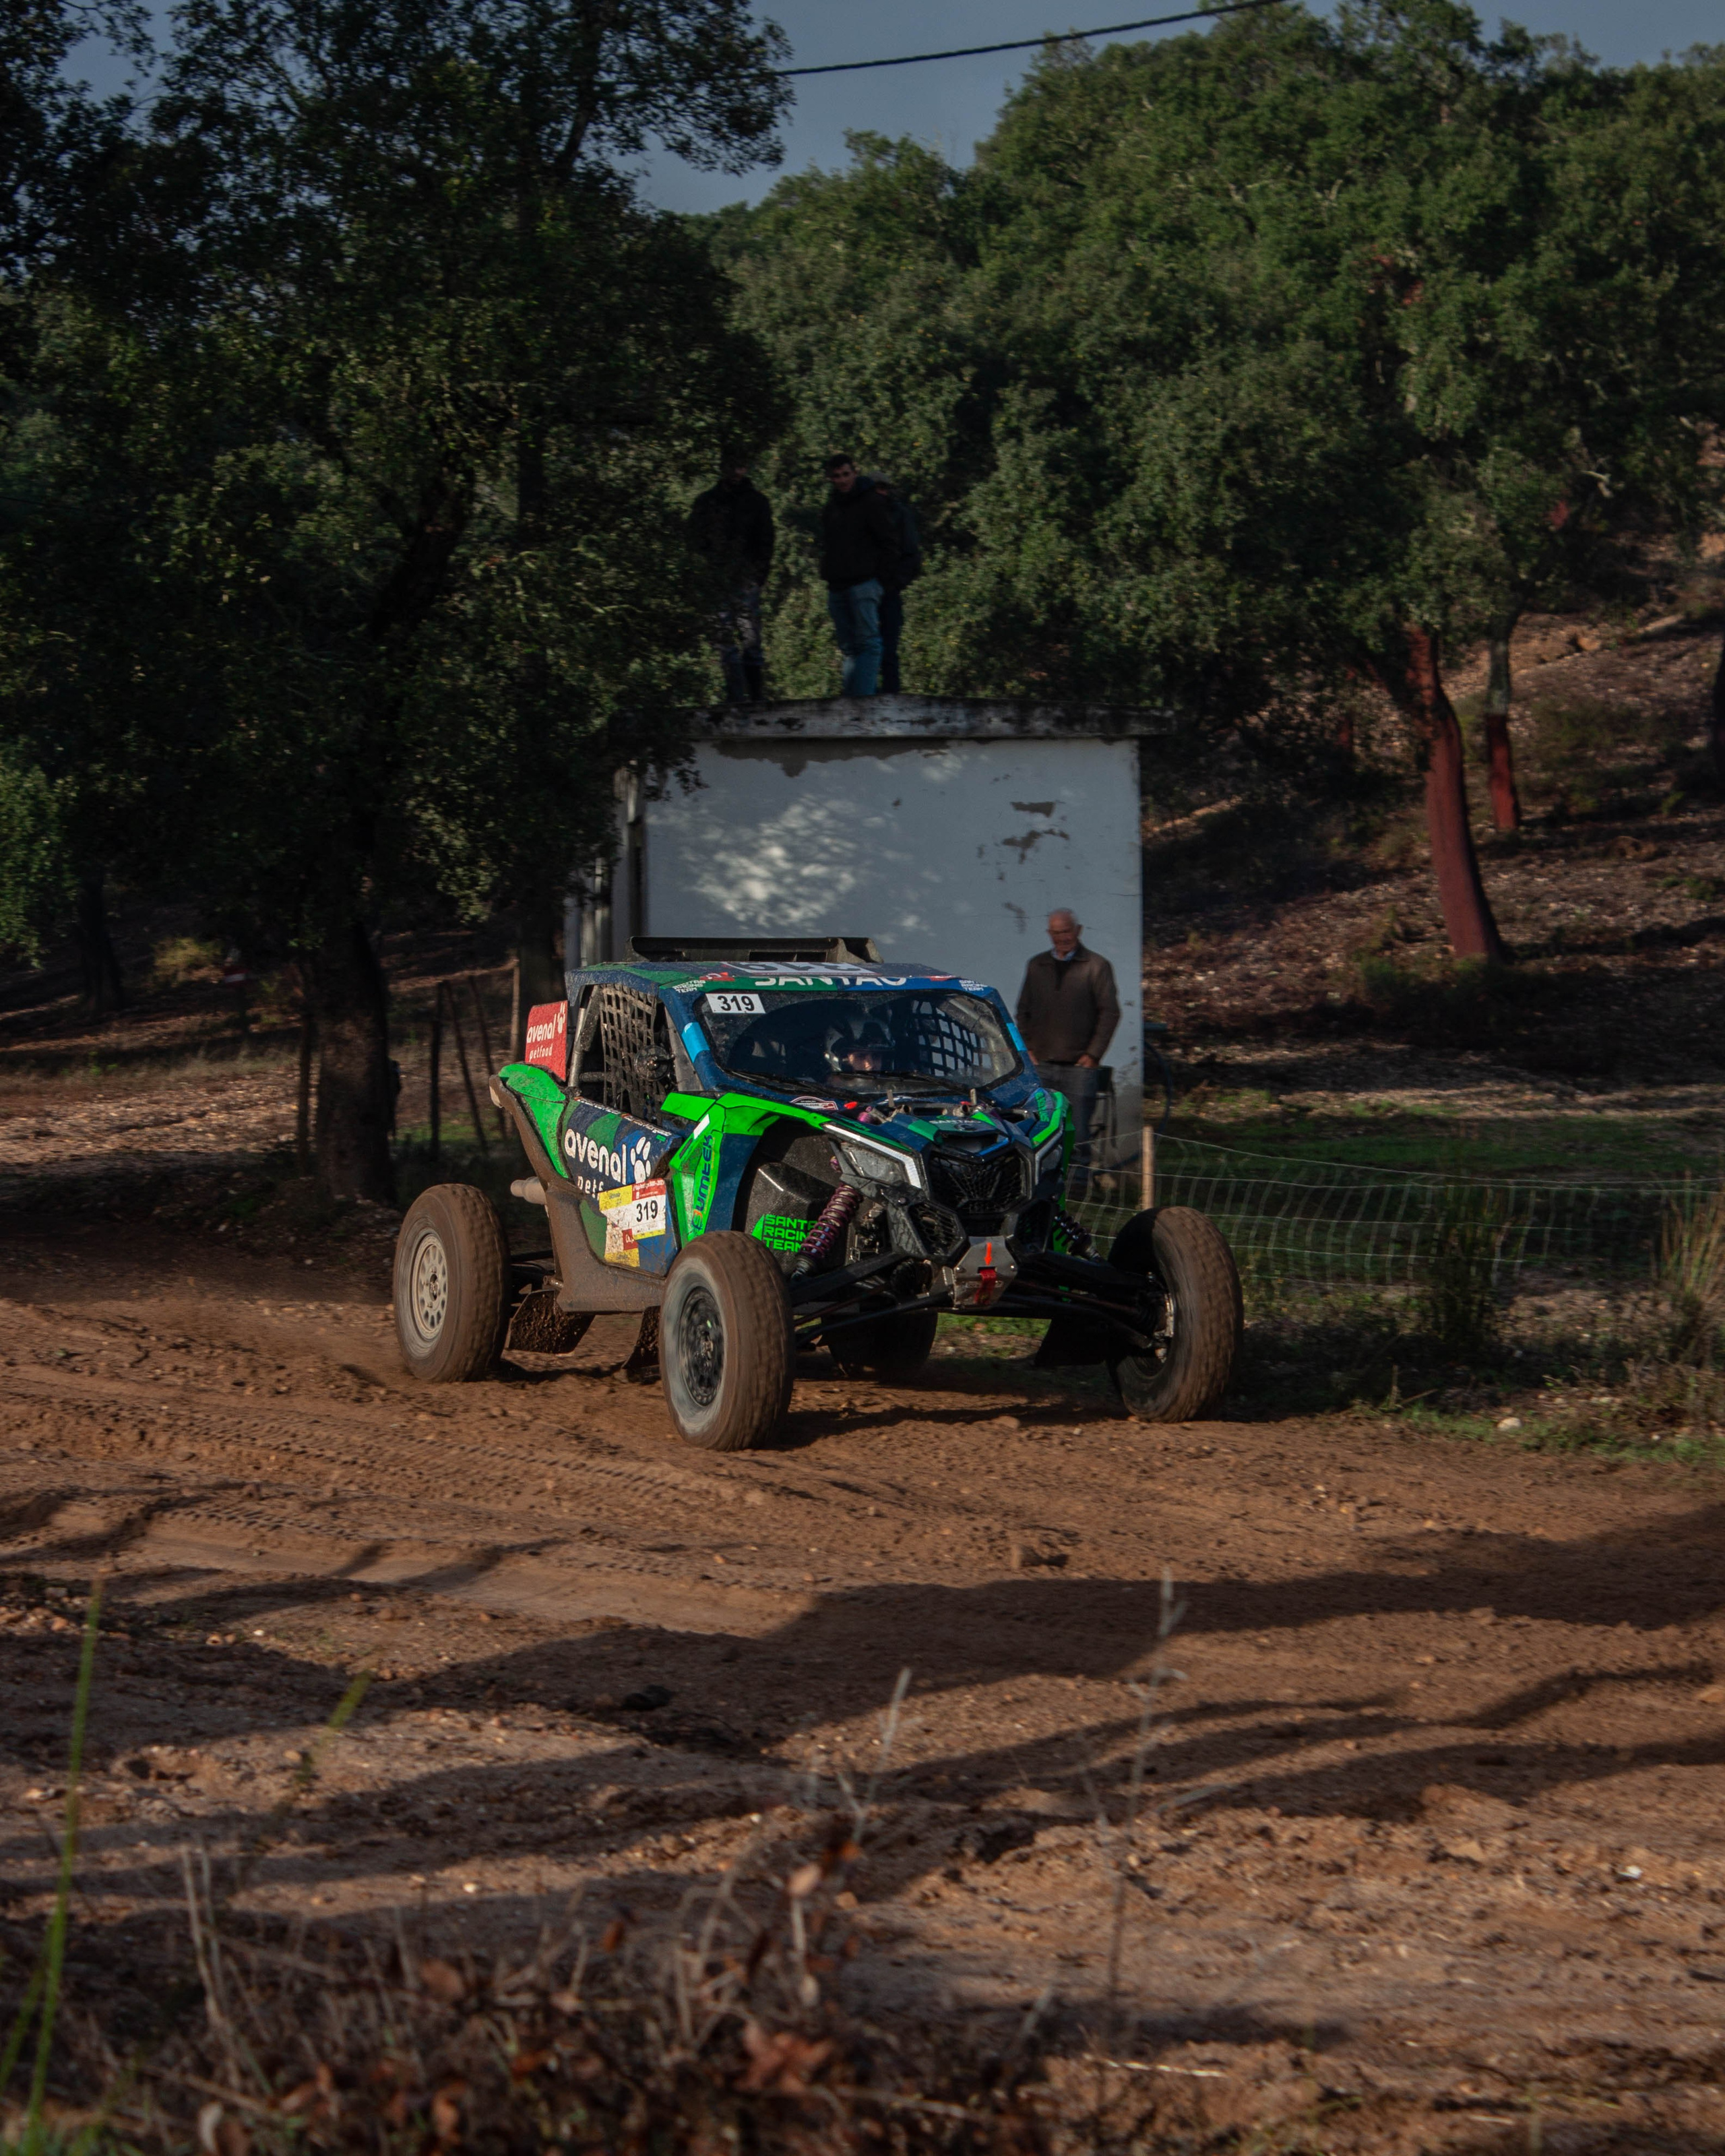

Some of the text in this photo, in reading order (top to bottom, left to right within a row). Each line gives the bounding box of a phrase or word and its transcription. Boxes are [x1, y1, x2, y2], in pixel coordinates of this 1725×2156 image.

[717, 995, 755, 1011] 319
[526, 1013, 557, 1044] avenal
[529, 1043, 553, 1063] petfood
[564, 1128, 627, 1186] avenal
[636, 1200, 658, 1223] 319
[764, 1213, 819, 1231] SANTA
[763, 1225, 810, 1242] RACIN
